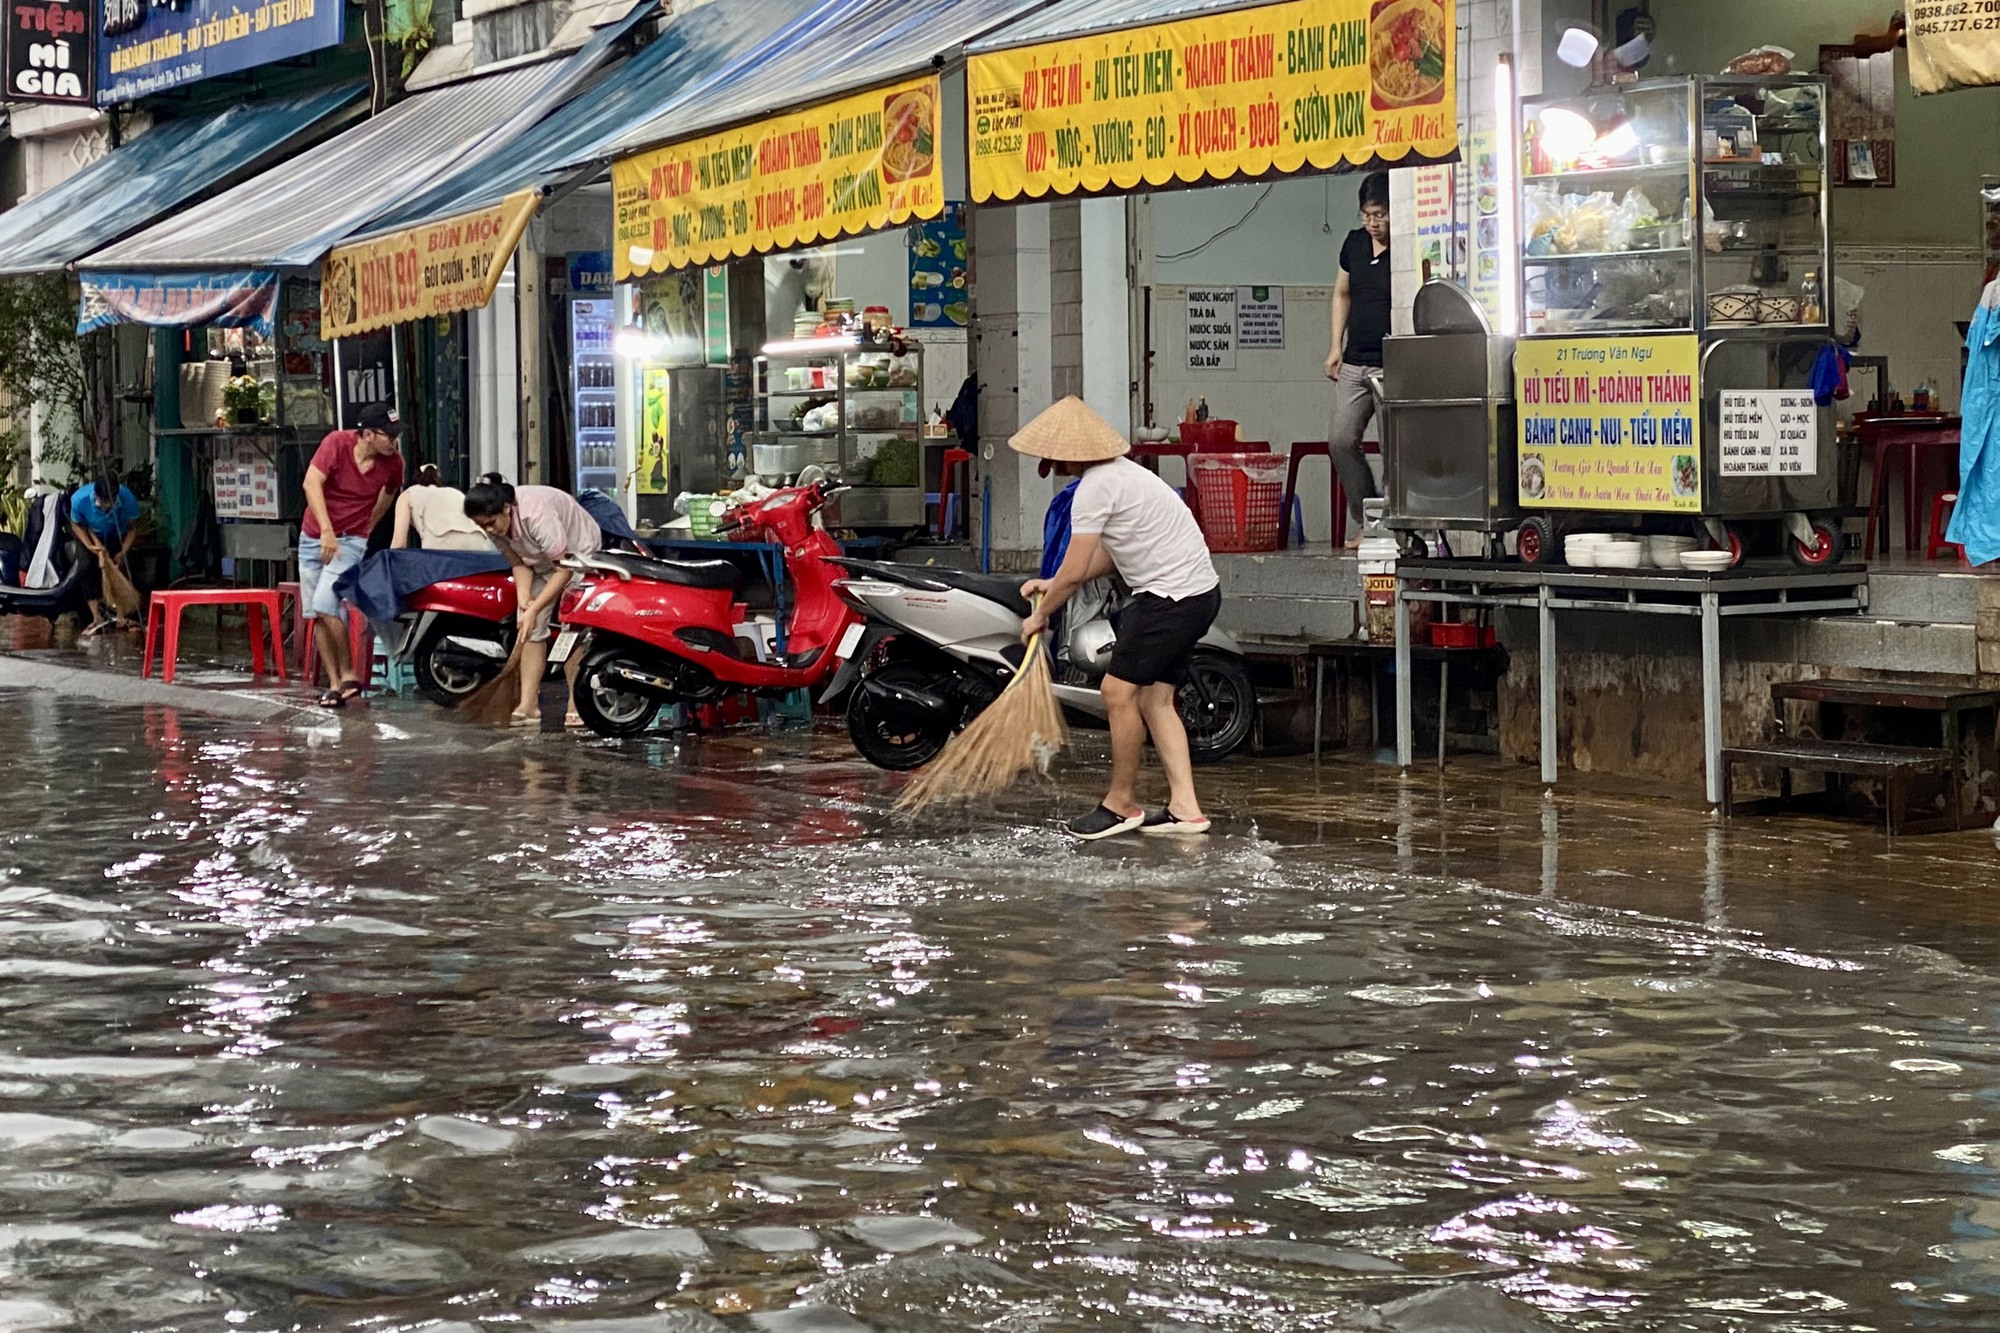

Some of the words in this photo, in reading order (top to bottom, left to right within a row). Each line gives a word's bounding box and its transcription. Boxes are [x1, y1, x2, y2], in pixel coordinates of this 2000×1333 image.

[15, 3, 84, 37] TIỆM
[29, 39, 69, 69] MÌ
[1023, 56, 1038, 111] HỦ
[1041, 52, 1065, 108] TIẾU
[1068, 53, 1082, 105] MÌ
[1094, 44, 1110, 101] HỦ
[1113, 41, 1139, 98] TIẾU
[1143, 33, 1173, 95] MỀM
[1185, 34, 1226, 89] HOÀNH
[1231, 27, 1274, 83] THÁNH
[1288, 19, 1324, 75] BÁNH
[1329, 19, 1366, 69] CANH
[16, 69, 81, 96] GIA
[760, 130, 790, 176] HOÀNH
[791, 121, 821, 168] THÁNH
[829, 112, 853, 159] BÁNH
[856, 111, 882, 153] CANH
[1026, 131, 1047, 173] NUI
[1056, 118, 1082, 178] MỘC
[1093, 117, 1133, 165] XƯƠNG
[1145, 105, 1166, 159] GIÒ
[1178, 103, 1191, 157] XÍ
[1194, 99, 1236, 159] QUÁCH
[1249, 92, 1280, 149] ĐUÔI
[1294, 84, 1331, 143] SƯỜN
[1334, 90, 1366, 138] NON
[653, 216, 667, 253] NUI
[673, 205, 691, 255] MỘC
[699, 202, 726, 243] XƯƠNG
[733, 189, 747, 236] GIÒ
[755, 187, 764, 231] XÍ
[766, 183, 795, 232] QUÁCH
[803, 174, 824, 221] ĐUÔI
[832, 166, 856, 215] SƯỜN
[858, 168, 882, 210] NON
[1189, 290, 1211, 302] NƯỚC
[1213, 292, 1234, 304] NGỌT
[1189, 306, 1203, 318] TRÀ
[1189, 322, 1211, 334] NƯỚC
[1213, 321, 1231, 334] SUỐI
[1189, 338, 1211, 350] NƯỚC
[1557, 349, 1568, 361] 21
[1572, 348, 1605, 362] Trương
[1609, 347, 1628, 360] Văn
[1631, 347, 1653, 362] Ngư
[1524, 368, 1540, 404] HỦ
[1544, 368, 1570, 404] TIẾU
[1574, 372, 1590, 404] MÌ
[1599, 370, 1643, 403] HOÀNH
[1647, 369, 1692, 403] THÁNH
[1525, 412, 1556, 446] BÁNH
[1560, 418, 1592, 446] CANH
[1601, 418, 1622, 446] NUI
[1630, 409, 1657, 446] TIẾU
[1661, 409, 1693, 446] MỀM
[1741, 446, 1756, 456] CANH
